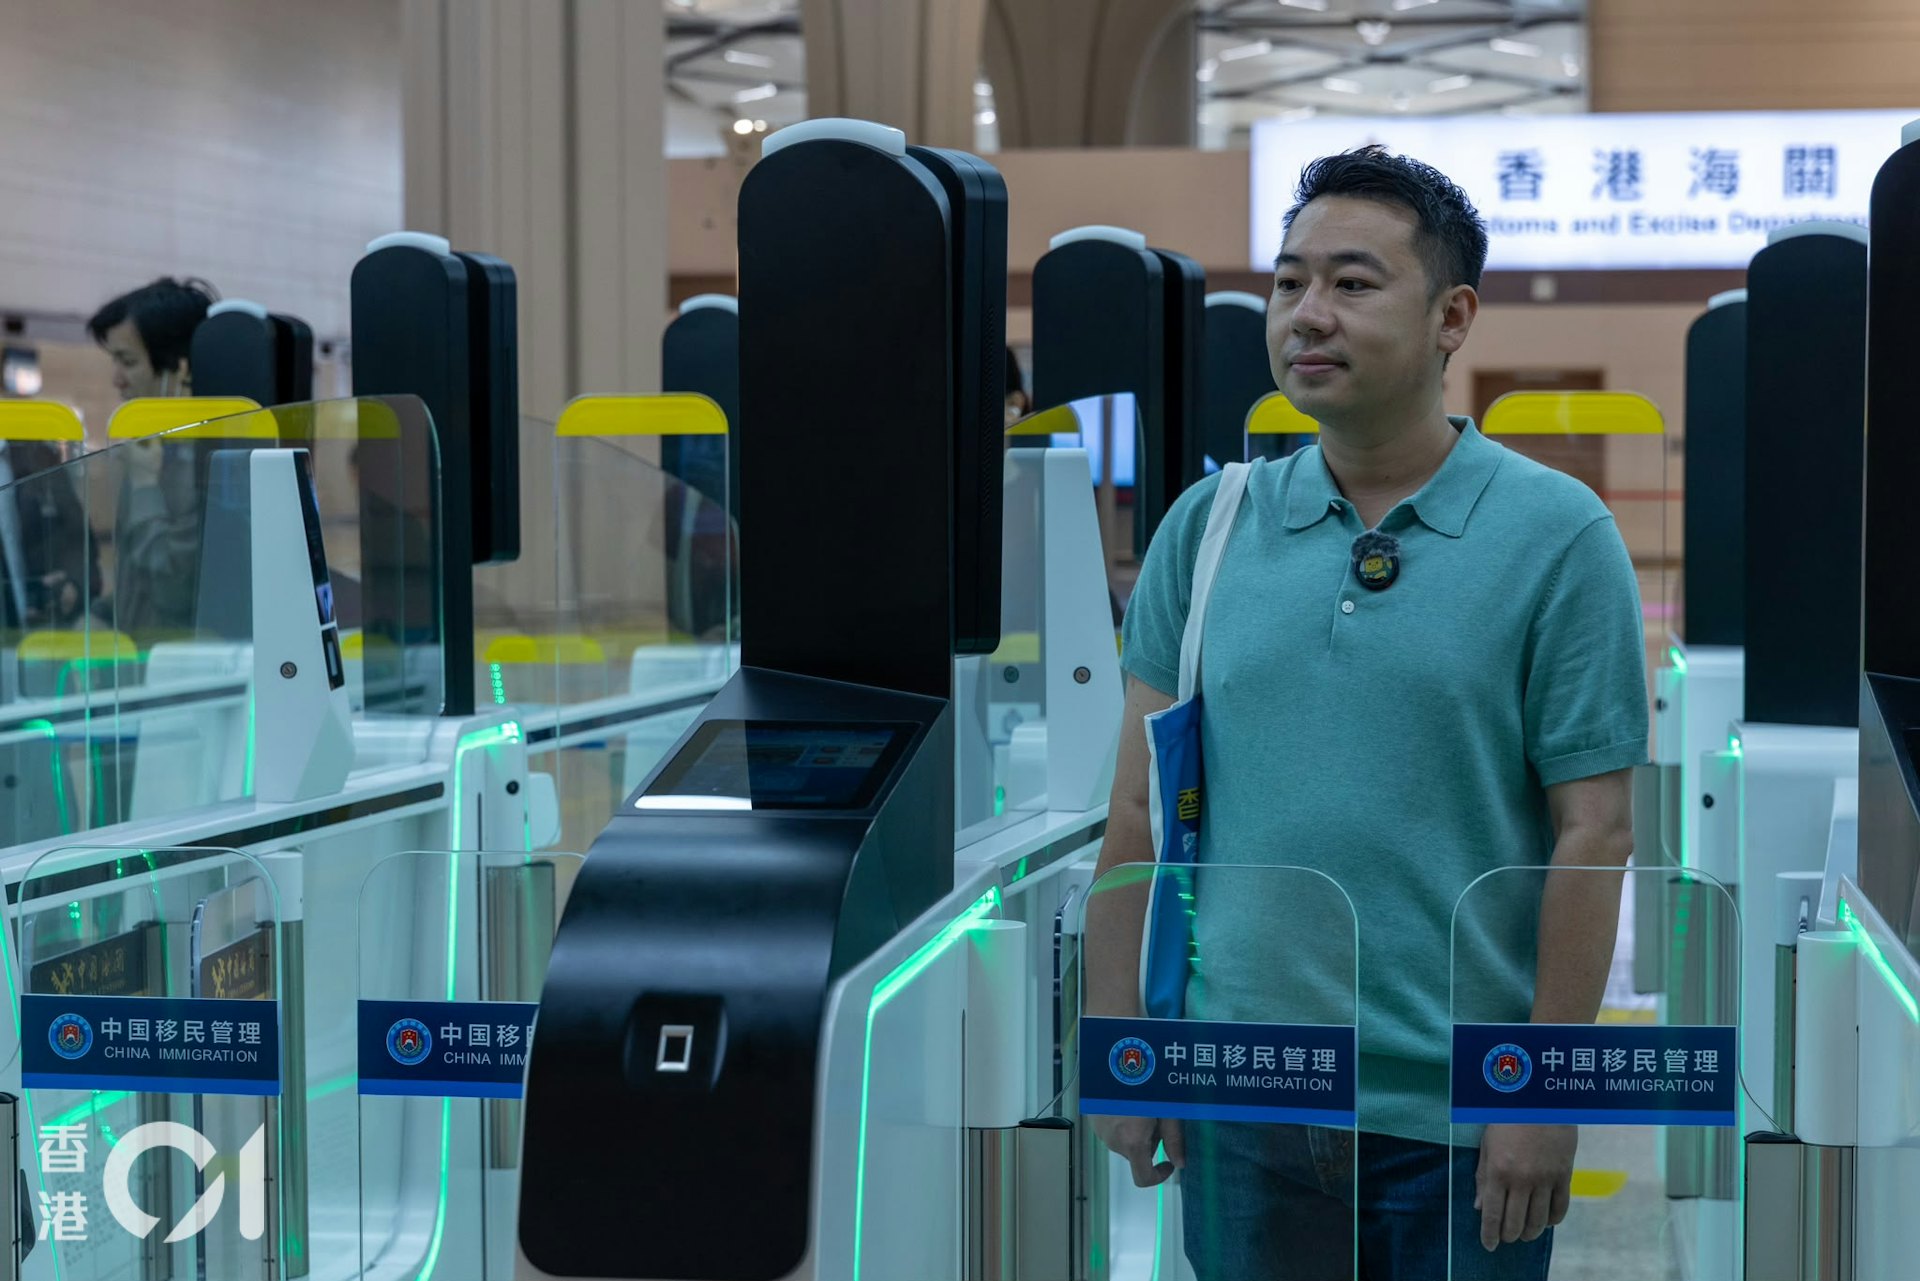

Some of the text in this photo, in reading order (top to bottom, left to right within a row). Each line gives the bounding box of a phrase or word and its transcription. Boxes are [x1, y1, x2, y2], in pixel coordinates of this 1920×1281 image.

[1497, 145, 1838, 201] 香港海關
[1571, 212, 1622, 236] and
[1628, 211, 1718, 236] Excise
[101, 1017, 262, 1045] 中国移民管理
[440, 1022, 534, 1048] 中国移
[104, 1046, 258, 1063] CHINA IMMIGRATION
[443, 1051, 491, 1065] CHINA
[1164, 1041, 1337, 1073] 中国移民管理
[1541, 1046, 1719, 1073] 中国移民管理
[1167, 1072, 1333, 1091] CHINA IMMIGRATION
[1544, 1077, 1714, 1092] CHINA IMMIGRATION
